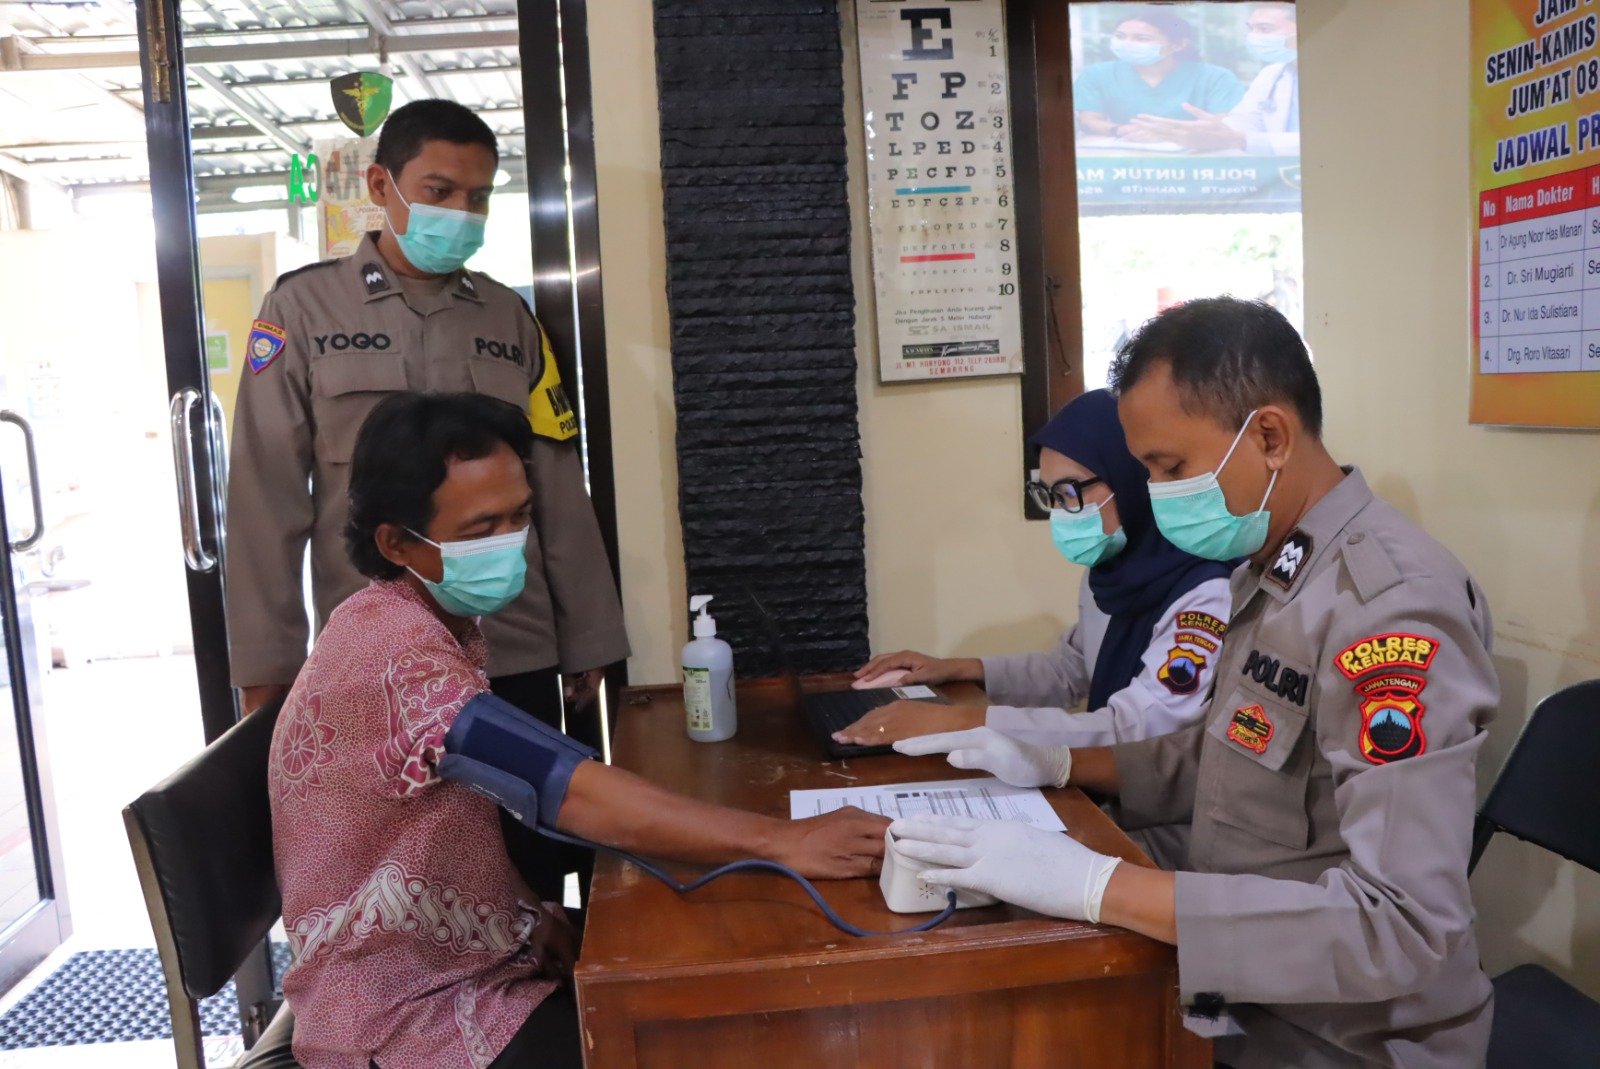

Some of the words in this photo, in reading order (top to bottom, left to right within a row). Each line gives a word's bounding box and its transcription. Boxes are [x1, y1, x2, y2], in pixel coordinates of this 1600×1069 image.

[900, 8, 954, 61] E
[988, 45, 997, 57] 1
[1487, 16, 1595, 83] SENIN-KAMIS
[892, 73, 917, 100] F
[940, 72, 966, 99] P
[991, 82, 1001, 95] 2
[1508, 70, 1571, 116] JUM'AT
[993, 116, 1003, 129] 3
[993, 141, 1003, 153] 4
[1494, 125, 1570, 172] JADWAL
[996, 165, 1006, 178] 5
[998, 195, 1008, 208] 6
[1483, 201, 1496, 217] No
[1505, 195, 1534, 213] Nama
[1537, 186, 1574, 207] Dokter
[998, 218, 1008, 231] 7
[1528, 230, 1545, 243] Noor
[1546, 227, 1559, 240] Has
[1560, 224, 1582, 238] Manan
[1000, 239, 1011, 252] 8
[1002, 263, 1012, 276] 9
[1521, 269, 1533, 283] Sri
[1535, 263, 1574, 283] Mugiarti
[998, 283, 1015, 296] 10
[1514, 309, 1526, 321] Nur
[1527, 307, 1539, 320] Ida
[1540, 304, 1578, 319] Sulistiana
[314, 333, 391, 355] YOGO
[1524, 347, 1540, 360] Roro
[1542, 345, 1571, 360] Vitasari
[1180, 613, 1226, 632] POLRES
[1180, 620, 1220, 636] KENDAL
[1340, 636, 1432, 671] POLRES
[1350, 649, 1425, 674] KENDAL
[1242, 649, 1309, 707] POLRI
